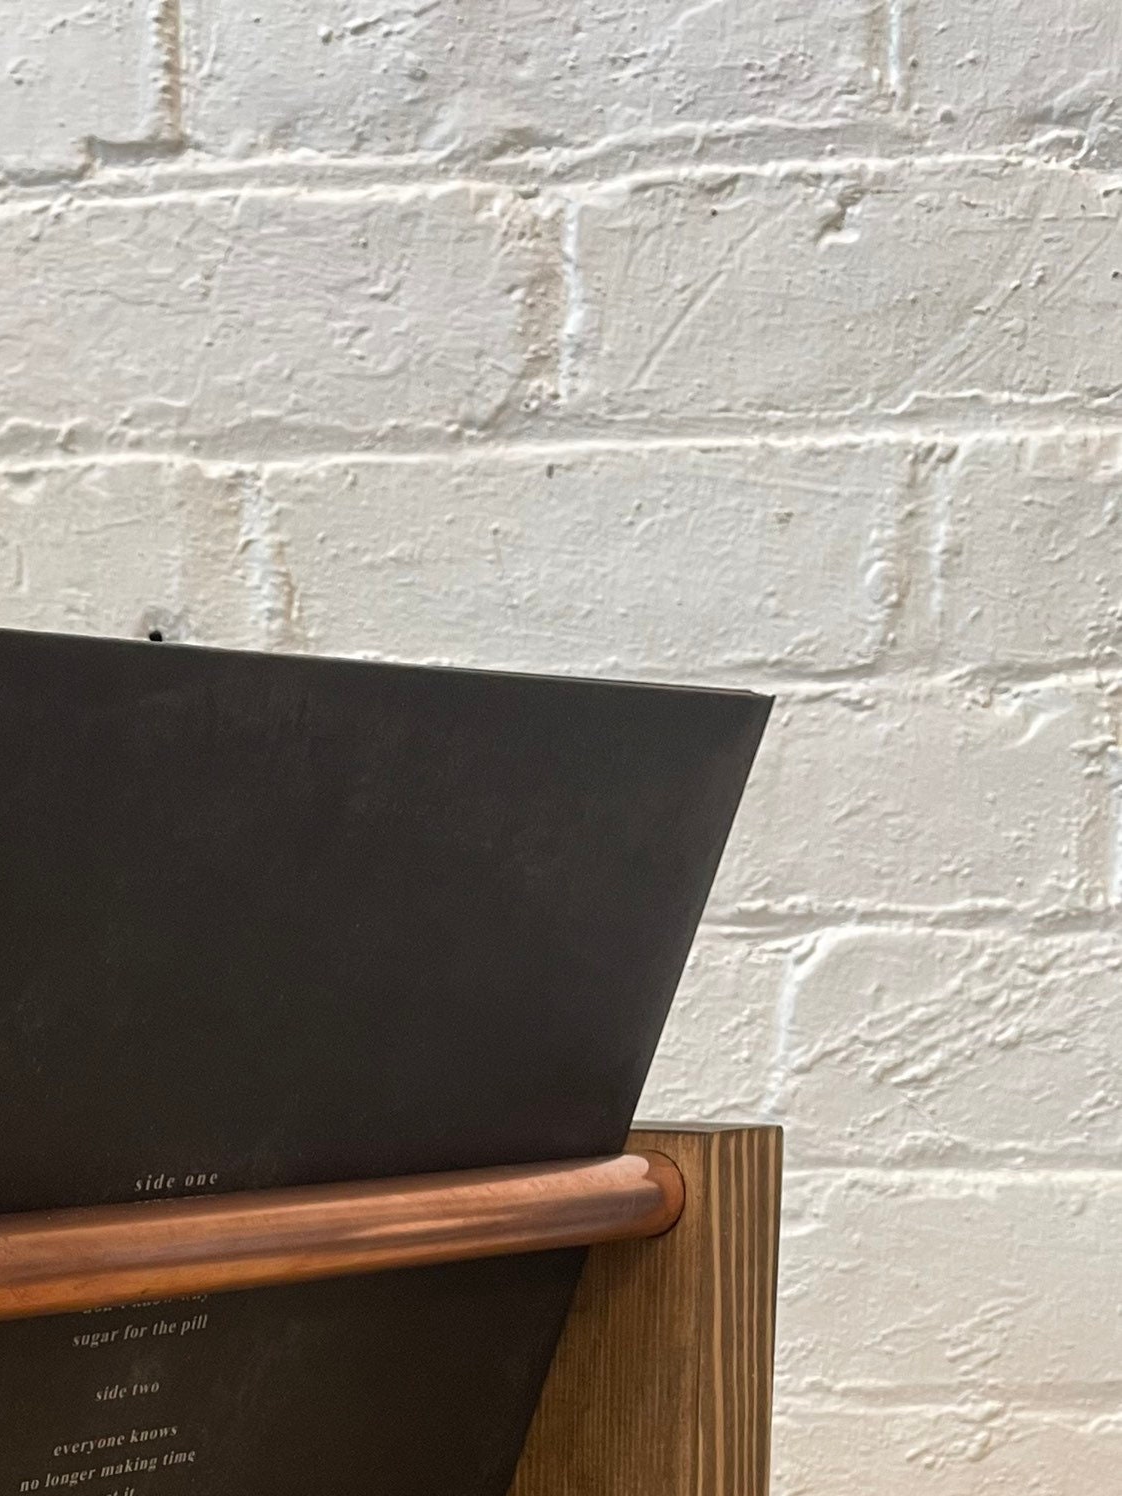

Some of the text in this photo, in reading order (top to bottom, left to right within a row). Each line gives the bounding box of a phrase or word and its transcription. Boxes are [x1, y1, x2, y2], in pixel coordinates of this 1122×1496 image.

[134, 1171, 219, 1192] side one
[72, 1314, 208, 1348] sugar for the pill
[95, 1381, 160, 1402] side two
[53, 1425, 178, 1457] everyone knows
[19, 1449, 196, 1493] no longer making time
